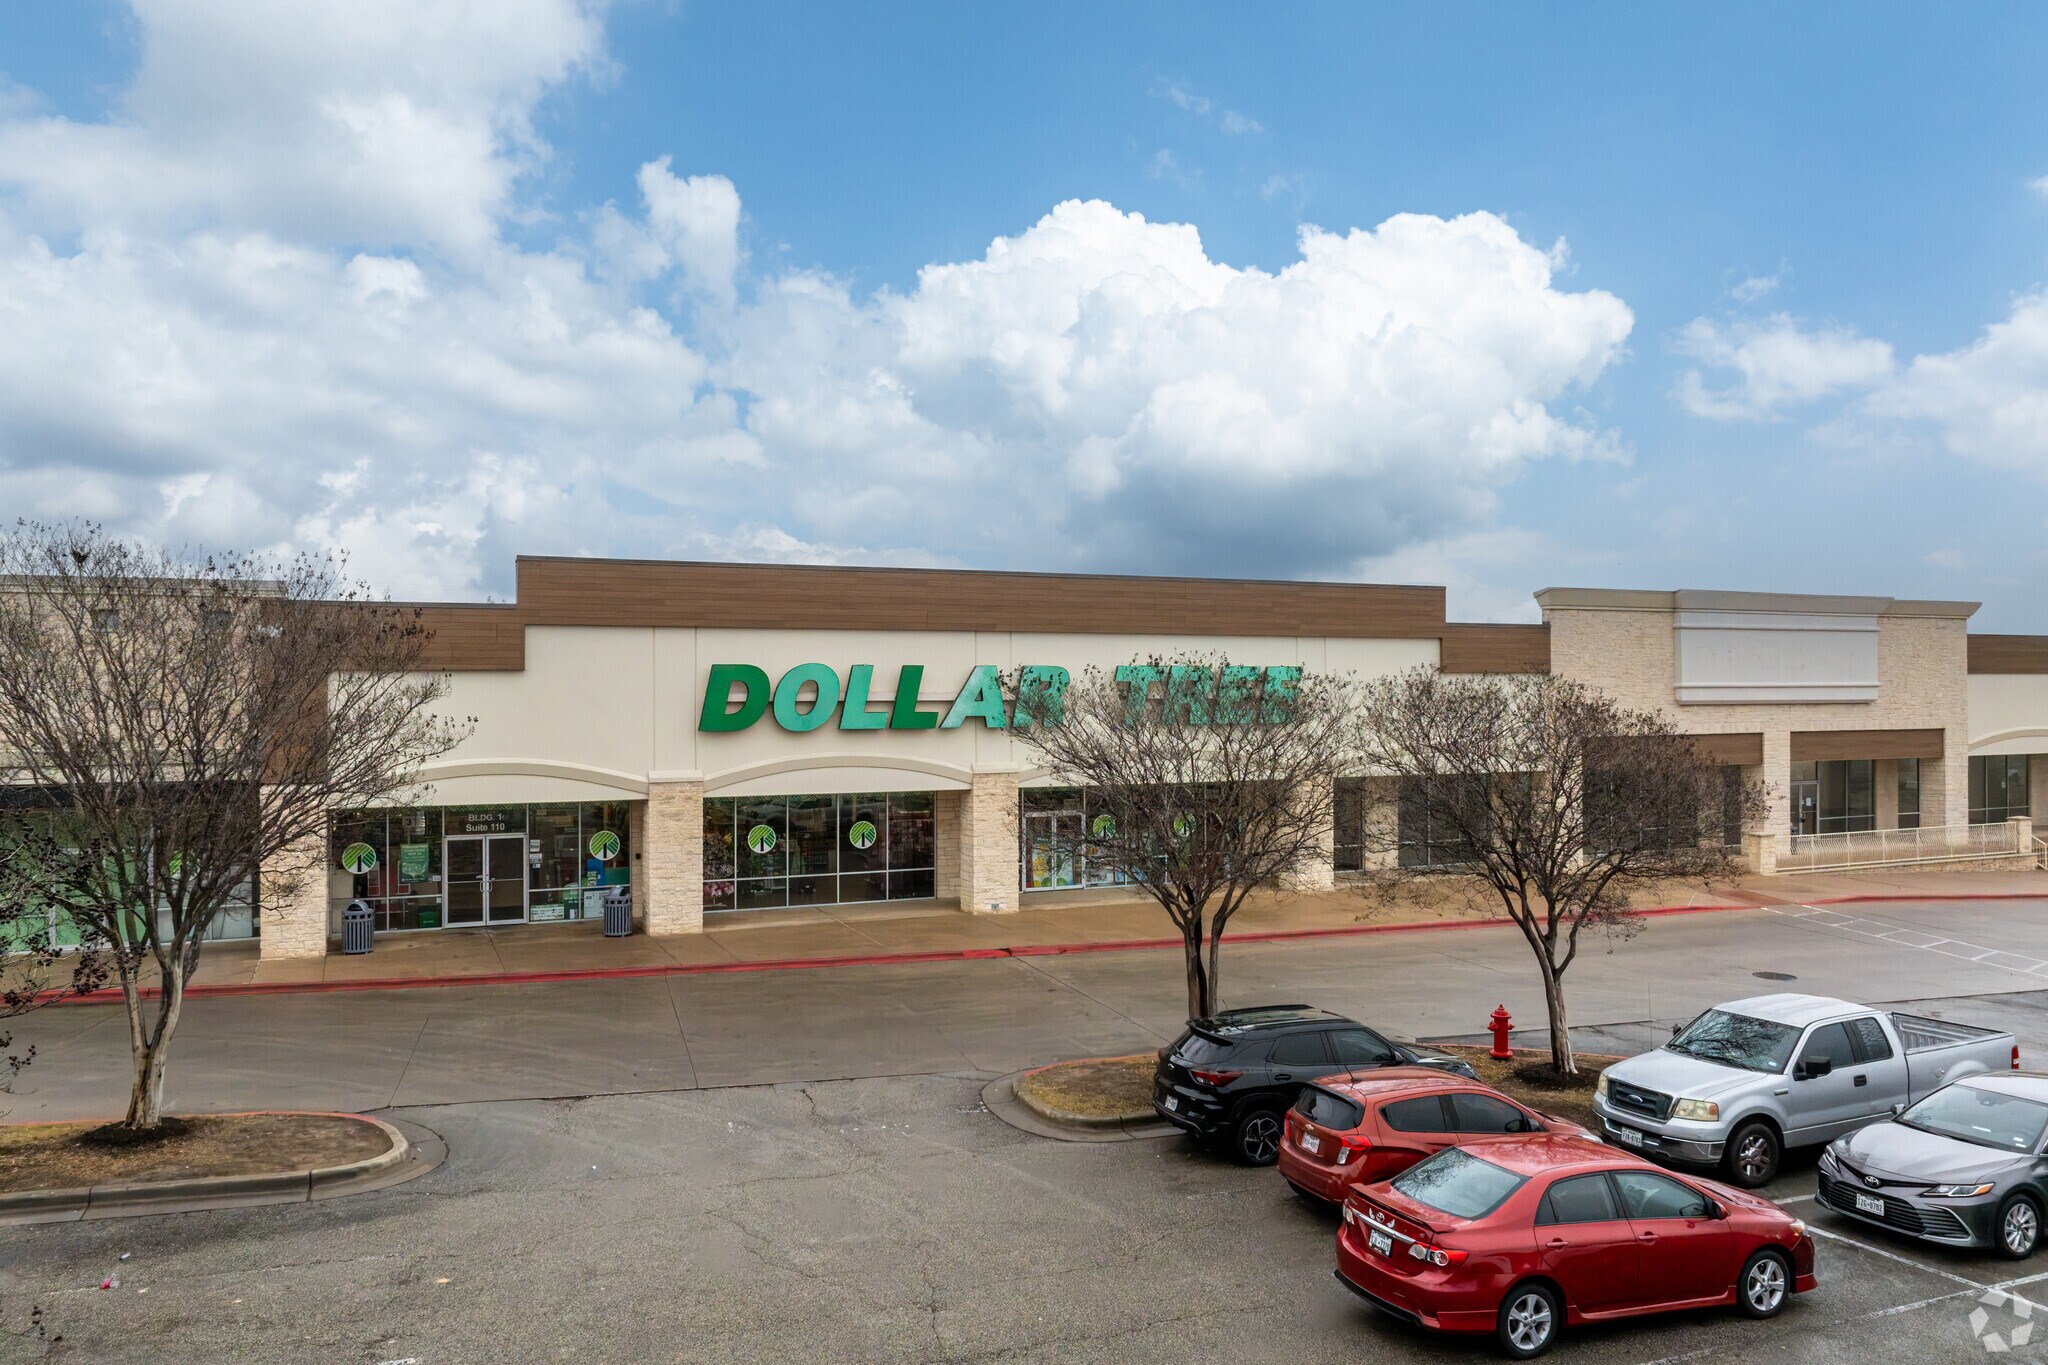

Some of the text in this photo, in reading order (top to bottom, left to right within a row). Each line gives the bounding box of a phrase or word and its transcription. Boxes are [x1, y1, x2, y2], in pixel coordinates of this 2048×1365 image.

[698, 662, 1305, 733] DOLLAR TREE
[468, 814, 495, 822] BLDG.
[465, 822, 505, 832] Suite 110
